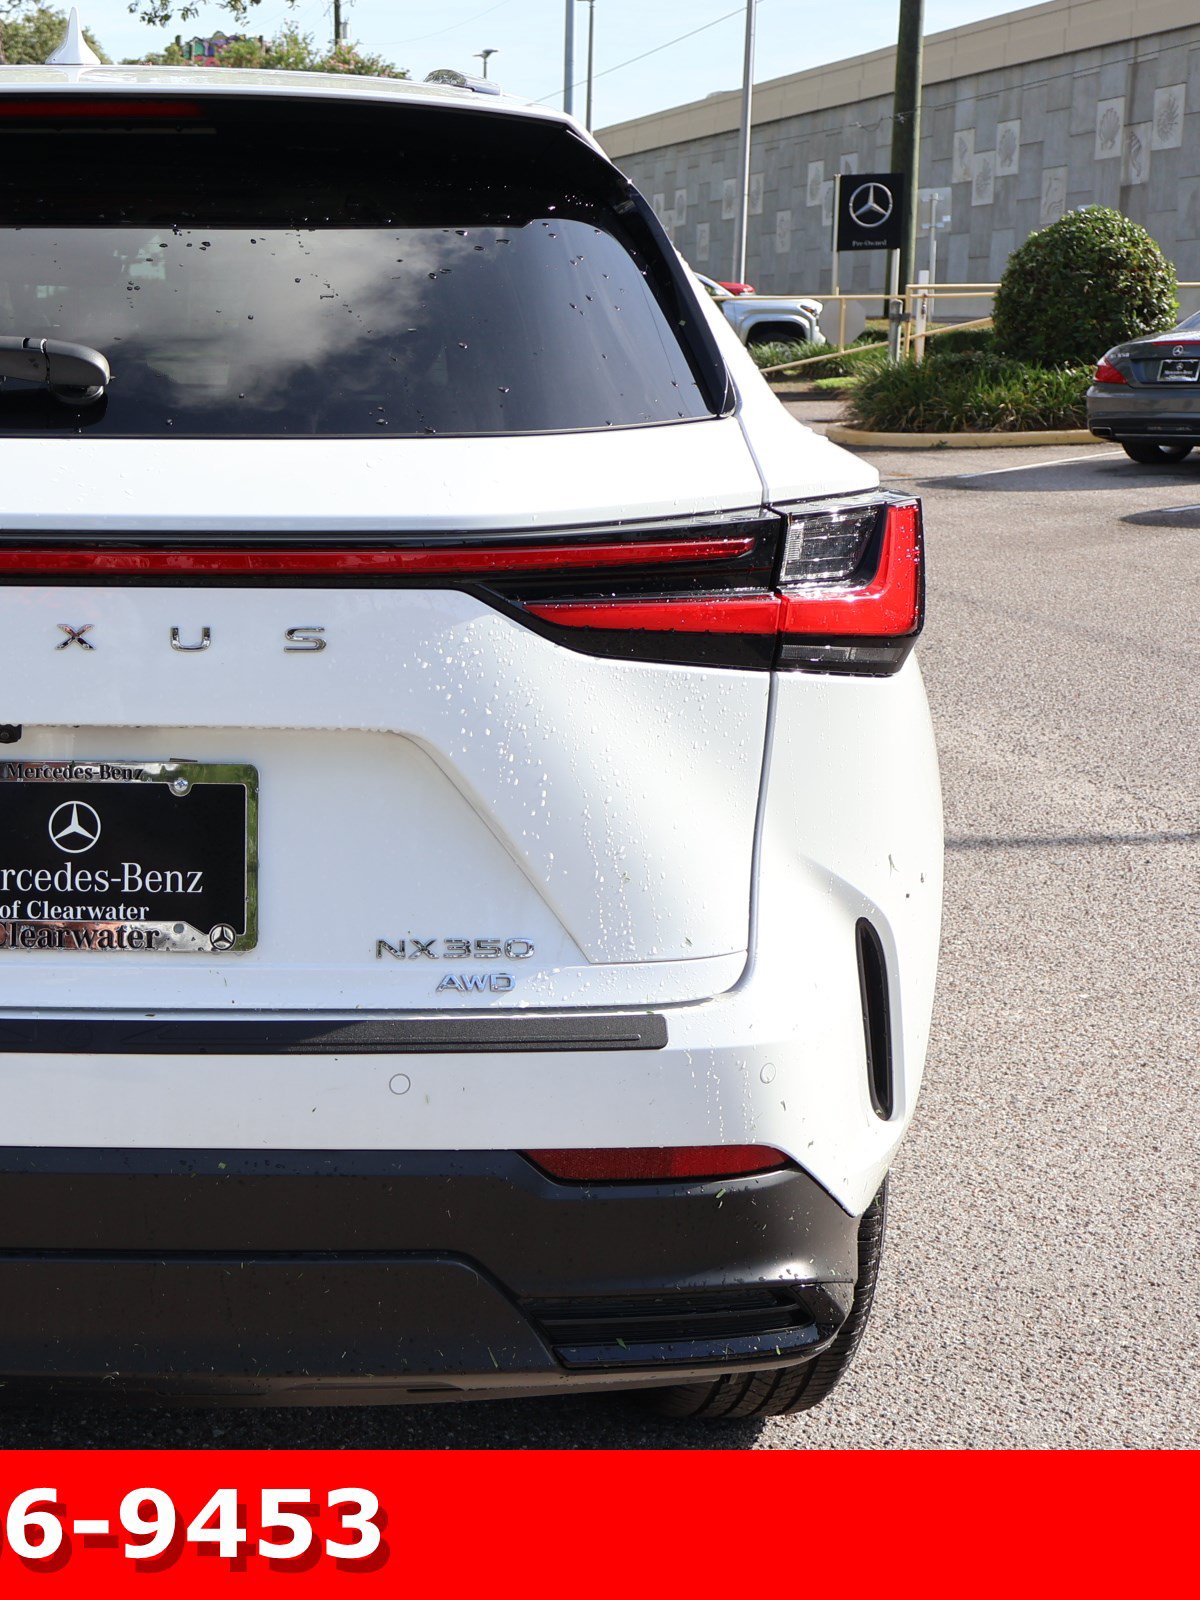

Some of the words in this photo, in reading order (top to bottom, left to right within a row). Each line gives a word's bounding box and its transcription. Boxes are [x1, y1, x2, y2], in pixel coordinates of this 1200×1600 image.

[6, 763, 144, 781] Mercedes-Benz
[0, 900, 21, 919] of
[26, 900, 150, 921] Clearwater
[375, 937, 536, 960] NX350
[436, 972, 516, 992] AWD
